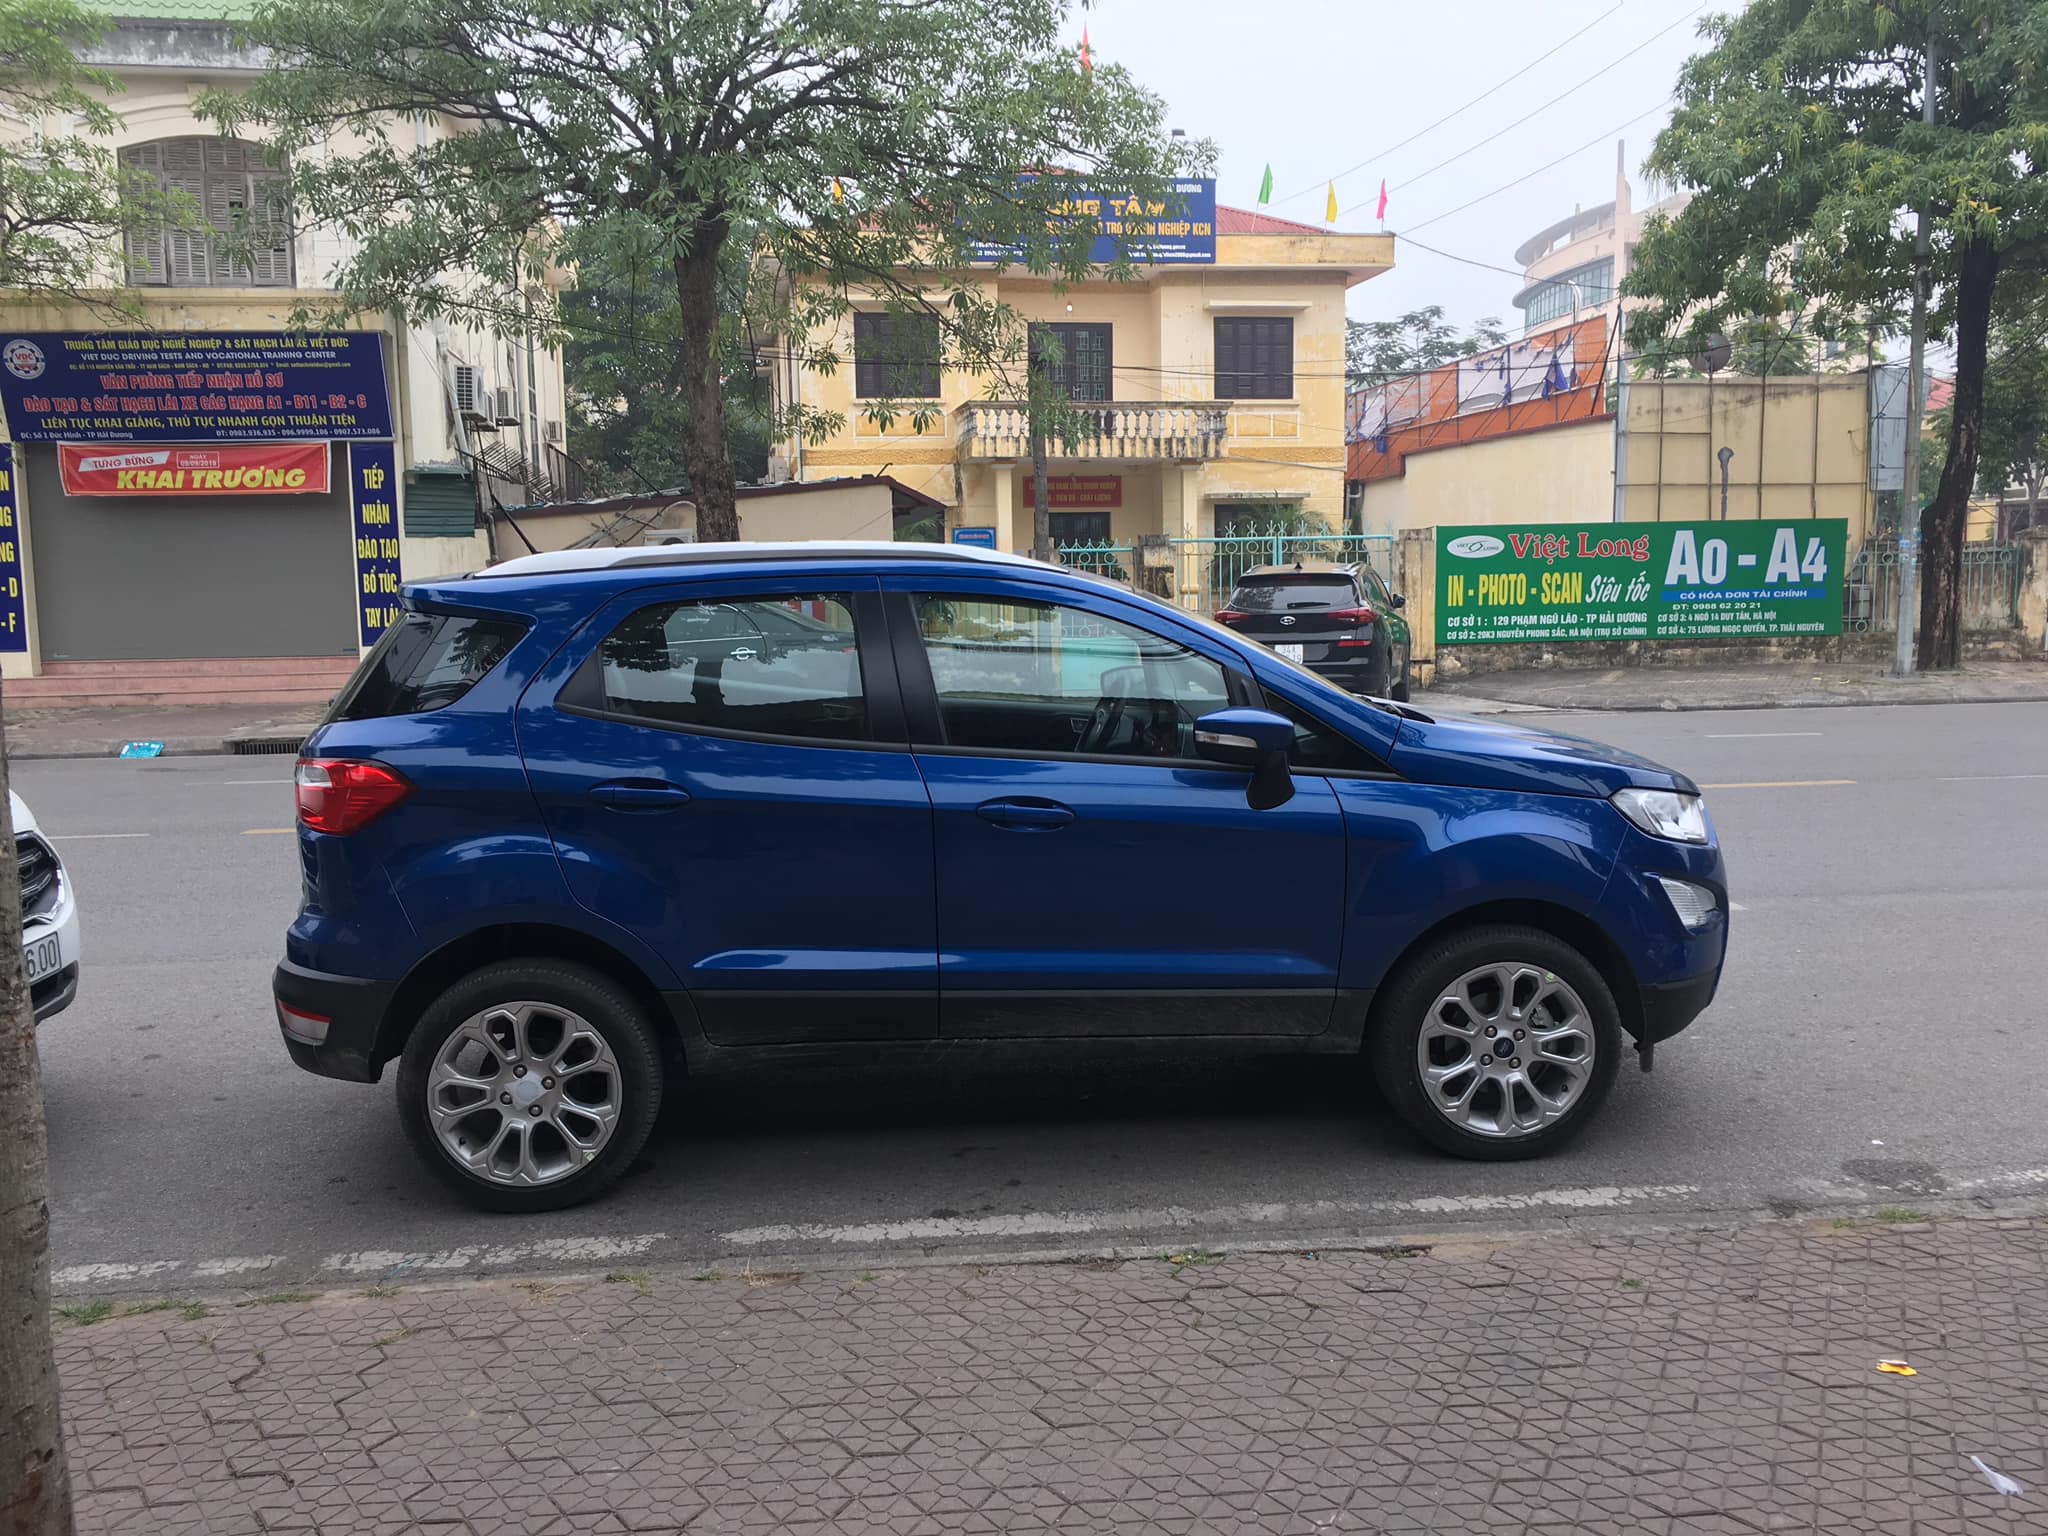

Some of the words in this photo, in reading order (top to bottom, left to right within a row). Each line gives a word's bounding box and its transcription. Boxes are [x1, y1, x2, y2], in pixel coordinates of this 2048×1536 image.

[1157, 218, 1191, 239] NGHIỆP
[1192, 221, 1211, 236] KCN
[64, 340, 94, 351] TRUNG
[96, 338, 116, 350] TÂM
[119, 337, 140, 350] GIÁO
[142, 339, 160, 351] DỤC
[188, 336, 222, 350] NGHIỆP
[225, 339, 232, 349] &
[234, 336, 251, 348] SÁT
[253, 338, 279, 351] HẠCH
[81, 353, 99, 361] VIET
[101, 353, 120, 361] DUC
[122, 353, 158, 361] DRIVING
[160, 352, 183, 360] TESTS
[184, 352, 204, 360] AND
[206, 351, 261, 360] VOCATIONAL
[262, 351, 303, 359] TRAINING
[304, 351, 336, 359] CENTER
[130, 371, 175, 390] PHÒNG
[176, 370, 204, 389] TIẾP
[207, 370, 244, 391] NHẬN
[265, 372, 284, 388] SƠ
[23, 395, 51, 413] ĐÀO
[53, 397, 79, 415] TẠO
[81, 397, 92, 412] &
[94, 394, 118, 412] SÁT
[121, 397, 156, 415] HẠCH
[157, 393, 179, 411] LÁI
[181, 395, 198, 411] XE
[200, 392, 226, 410] CÁC
[229, 395, 265, 414] HẠNG
[266, 395, 283, 409] A1
[294, 394, 318, 409] B11
[329, 394, 347, 409] B2
[356, 394, 367, 409] C
[41, 415, 67, 429] LIÊN
[69, 417, 92, 431] TỤC
[94, 417, 122, 429] KHAI
[193, 416, 215, 431] TỤC
[217, 415, 259, 427] NHANH
[261, 415, 286, 429] GỌN
[287, 412, 328, 429] THUẬN
[329, 412, 356, 428] TIỆN
[116, 469, 184, 490] KHAI
[191, 466, 306, 489] TRƯƠNG
[362, 462, 385, 490] TIẾP
[362, 499, 390, 529] NHẬN
[357, 534, 378, 559] ĐÀO
[379, 538, 399, 563] TẠO
[1508, 532, 1569, 565] Việt
[1577, 532, 1649, 562] Long
[1738, 554, 1757, 566] -
[1764, 527, 1828, 583] A4
[8, 577, 18, 598] D
[1447, 575, 1465, 607] IN
[1478, 572, 1527, 607] PHOTO
[1541, 571, 1583, 605] SCAN
[1585, 574, 1623, 604] Siêu
[1624, 570, 1651, 602] tốc
[1679, 590, 1697, 600] CÓ
[1698, 590, 1723, 600] HÓA
[1725, 589, 1750, 599] ĐƠN
[1773, 588, 1808, 598] CHÍNH
[1657, 613, 1668, 623] CƠ
[1668, 611, 1679, 622] SỞ
[1672, 603, 1690, 611] ĐT:
[1719, 602, 1733, 610] 62
[1734, 602, 1748, 610] 20
[8, 612, 16, 633] F
[364, 607, 381, 629] TAY
[1447, 616, 1461, 627] CƠ
[1462, 613, 1475, 627] SỞ
[1493, 615, 1509, 626] 129
[1510, 614, 1538, 628] PHẠM
[1586, 613, 1597, 624] TP
[1599, 610, 1615, 623] HẢI
[1616, 611, 1648, 623] DƯƠNG
[1526, 629, 1550, 639] PHONG
[1687, 625, 1697, 635] 75
[1722, 624, 1742, 635] NGỌC
